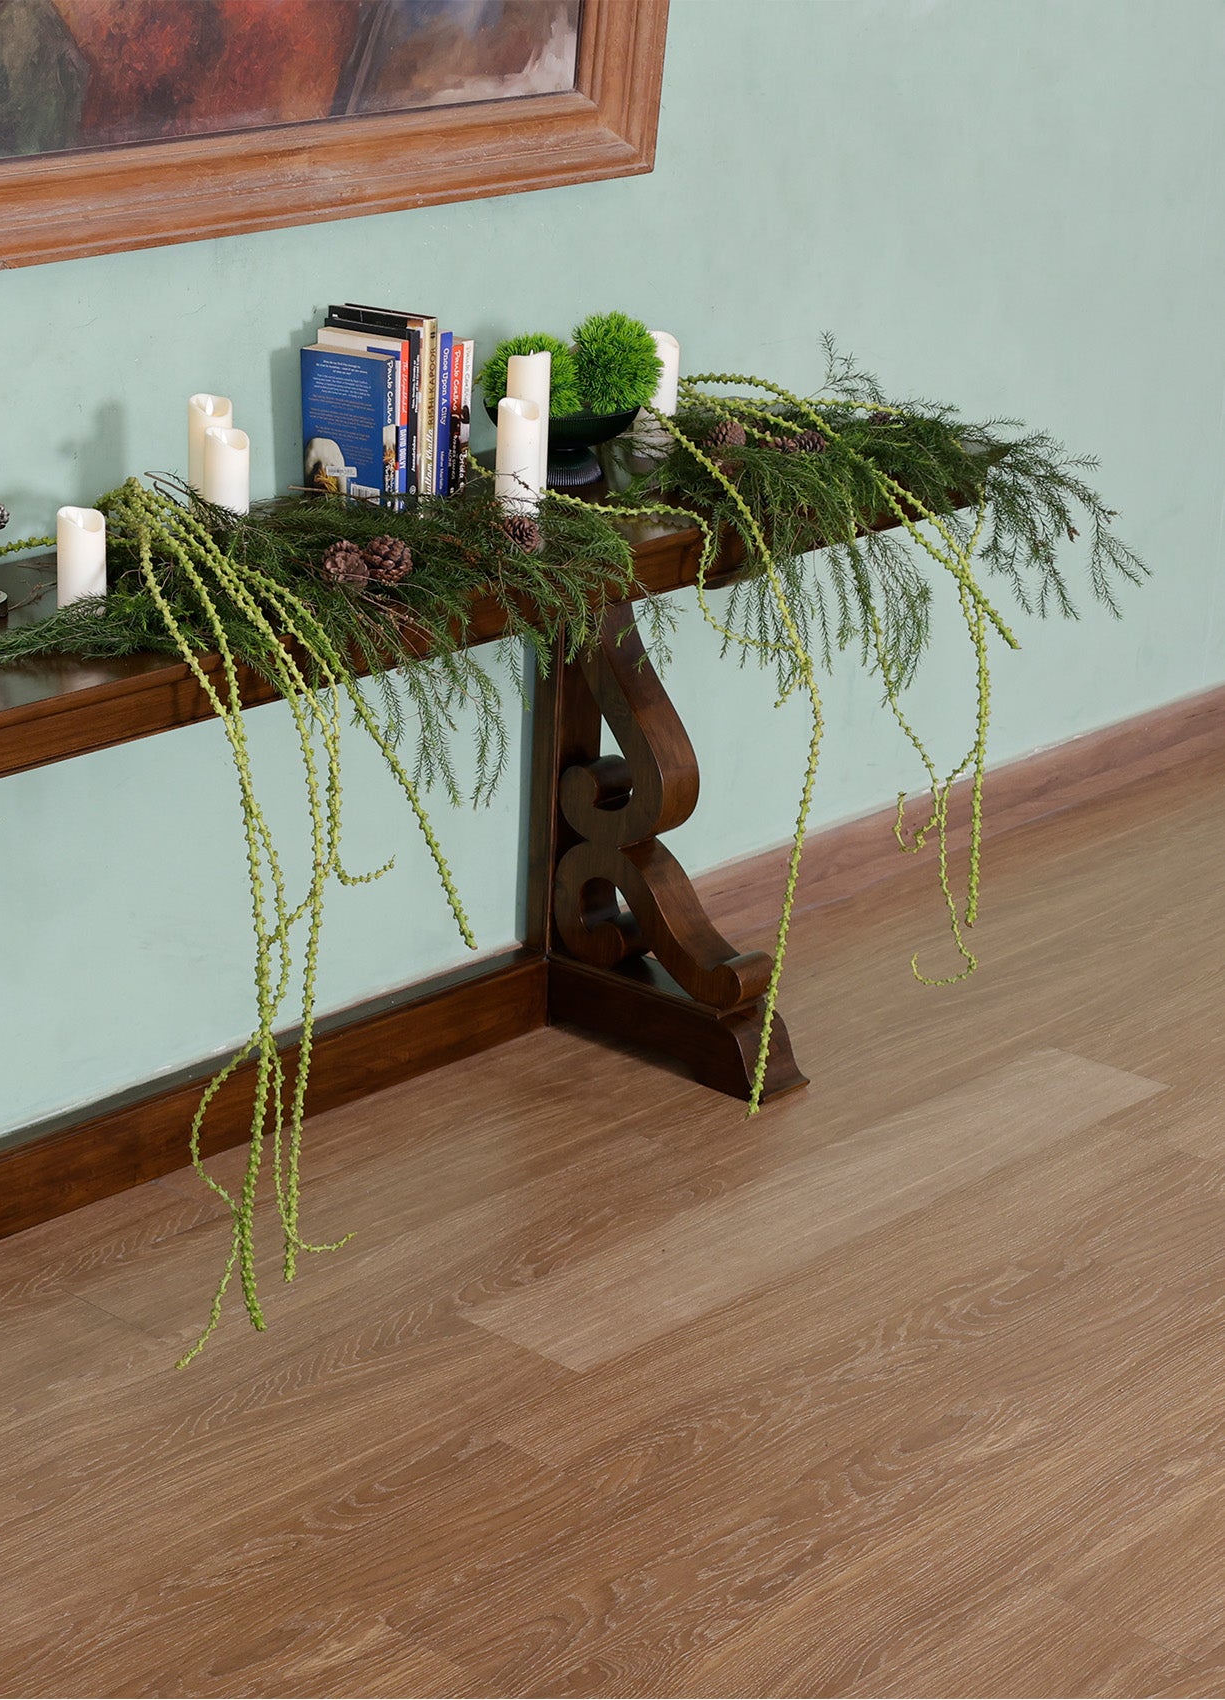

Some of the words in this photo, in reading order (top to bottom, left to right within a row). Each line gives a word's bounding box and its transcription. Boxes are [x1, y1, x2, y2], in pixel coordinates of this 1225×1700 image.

[429, 346, 437, 393] KAPOOR
[452, 380, 460, 411] Coelho
[399, 429, 407, 447] DAVID
